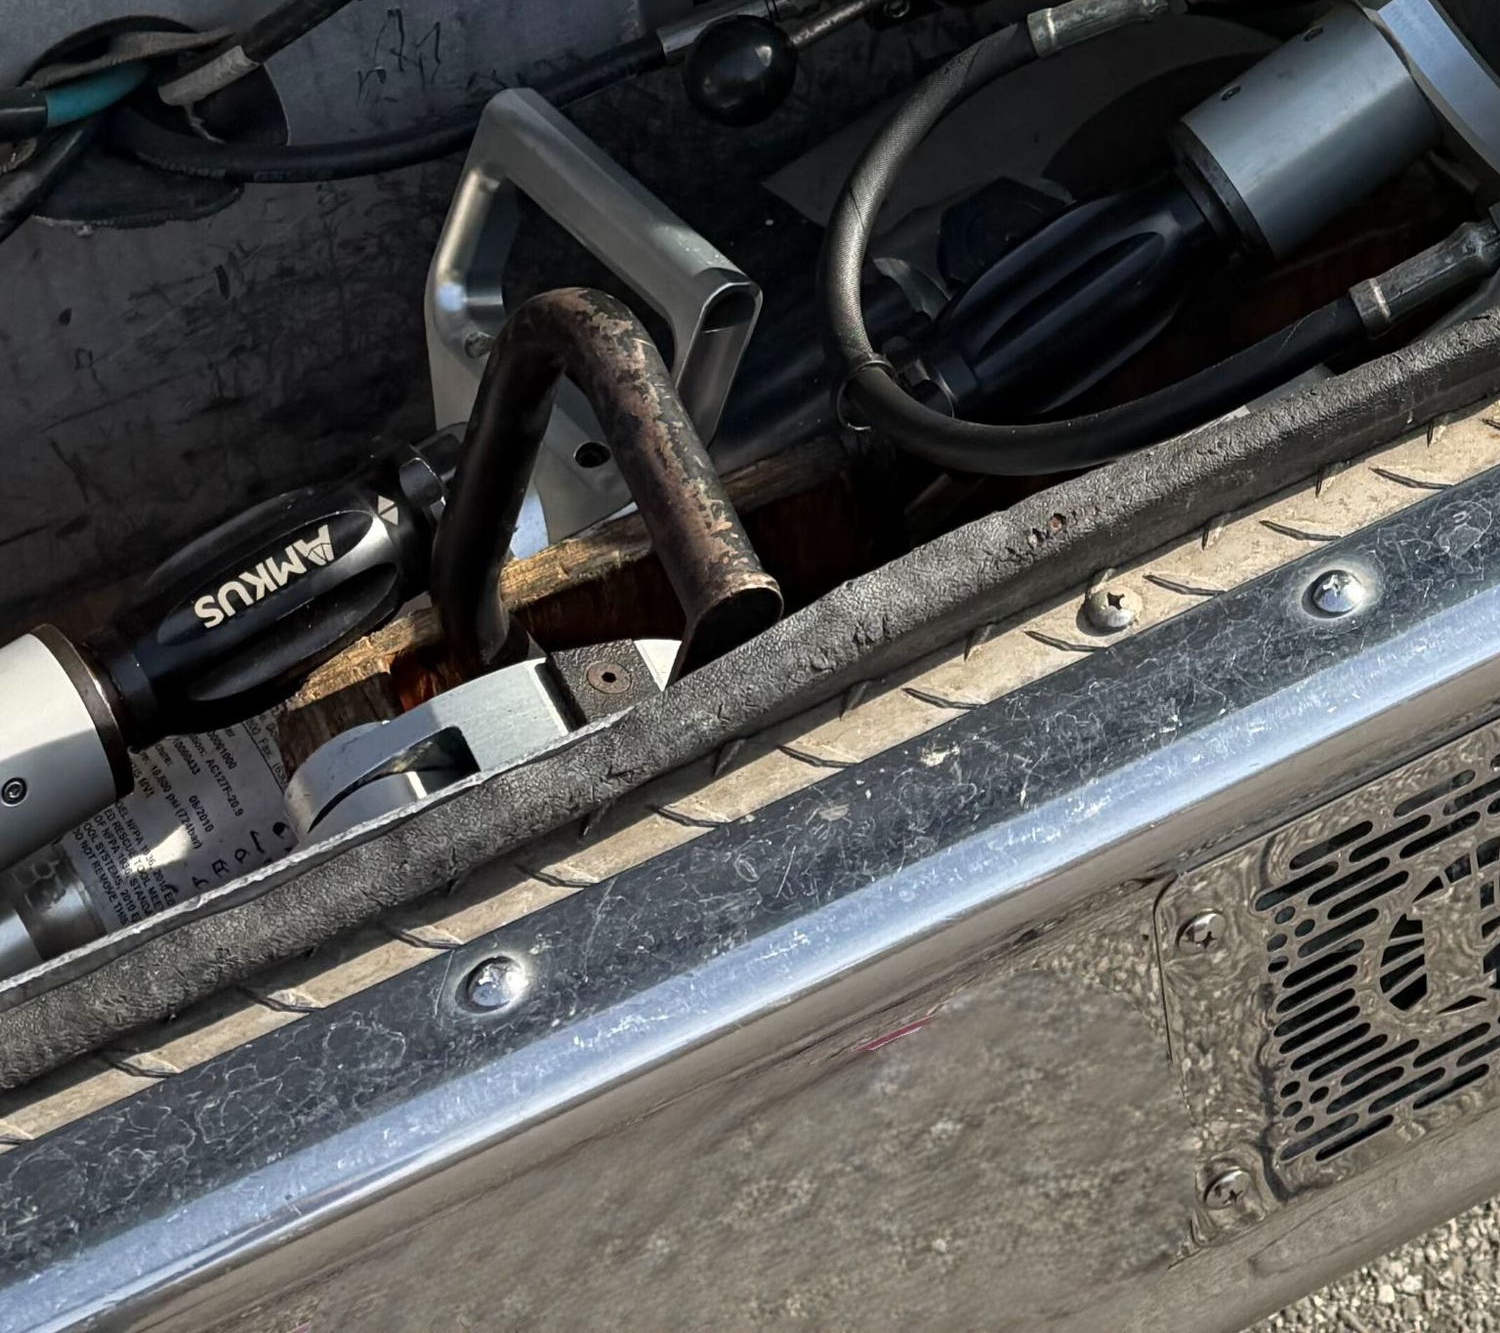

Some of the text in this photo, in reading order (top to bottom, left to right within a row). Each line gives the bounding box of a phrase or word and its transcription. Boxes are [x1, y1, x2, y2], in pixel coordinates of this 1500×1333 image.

[194, 524, 334, 628] AMKUS
[82, 821, 99, 843] OOL
[90, 860, 117, 902] REMOVE
